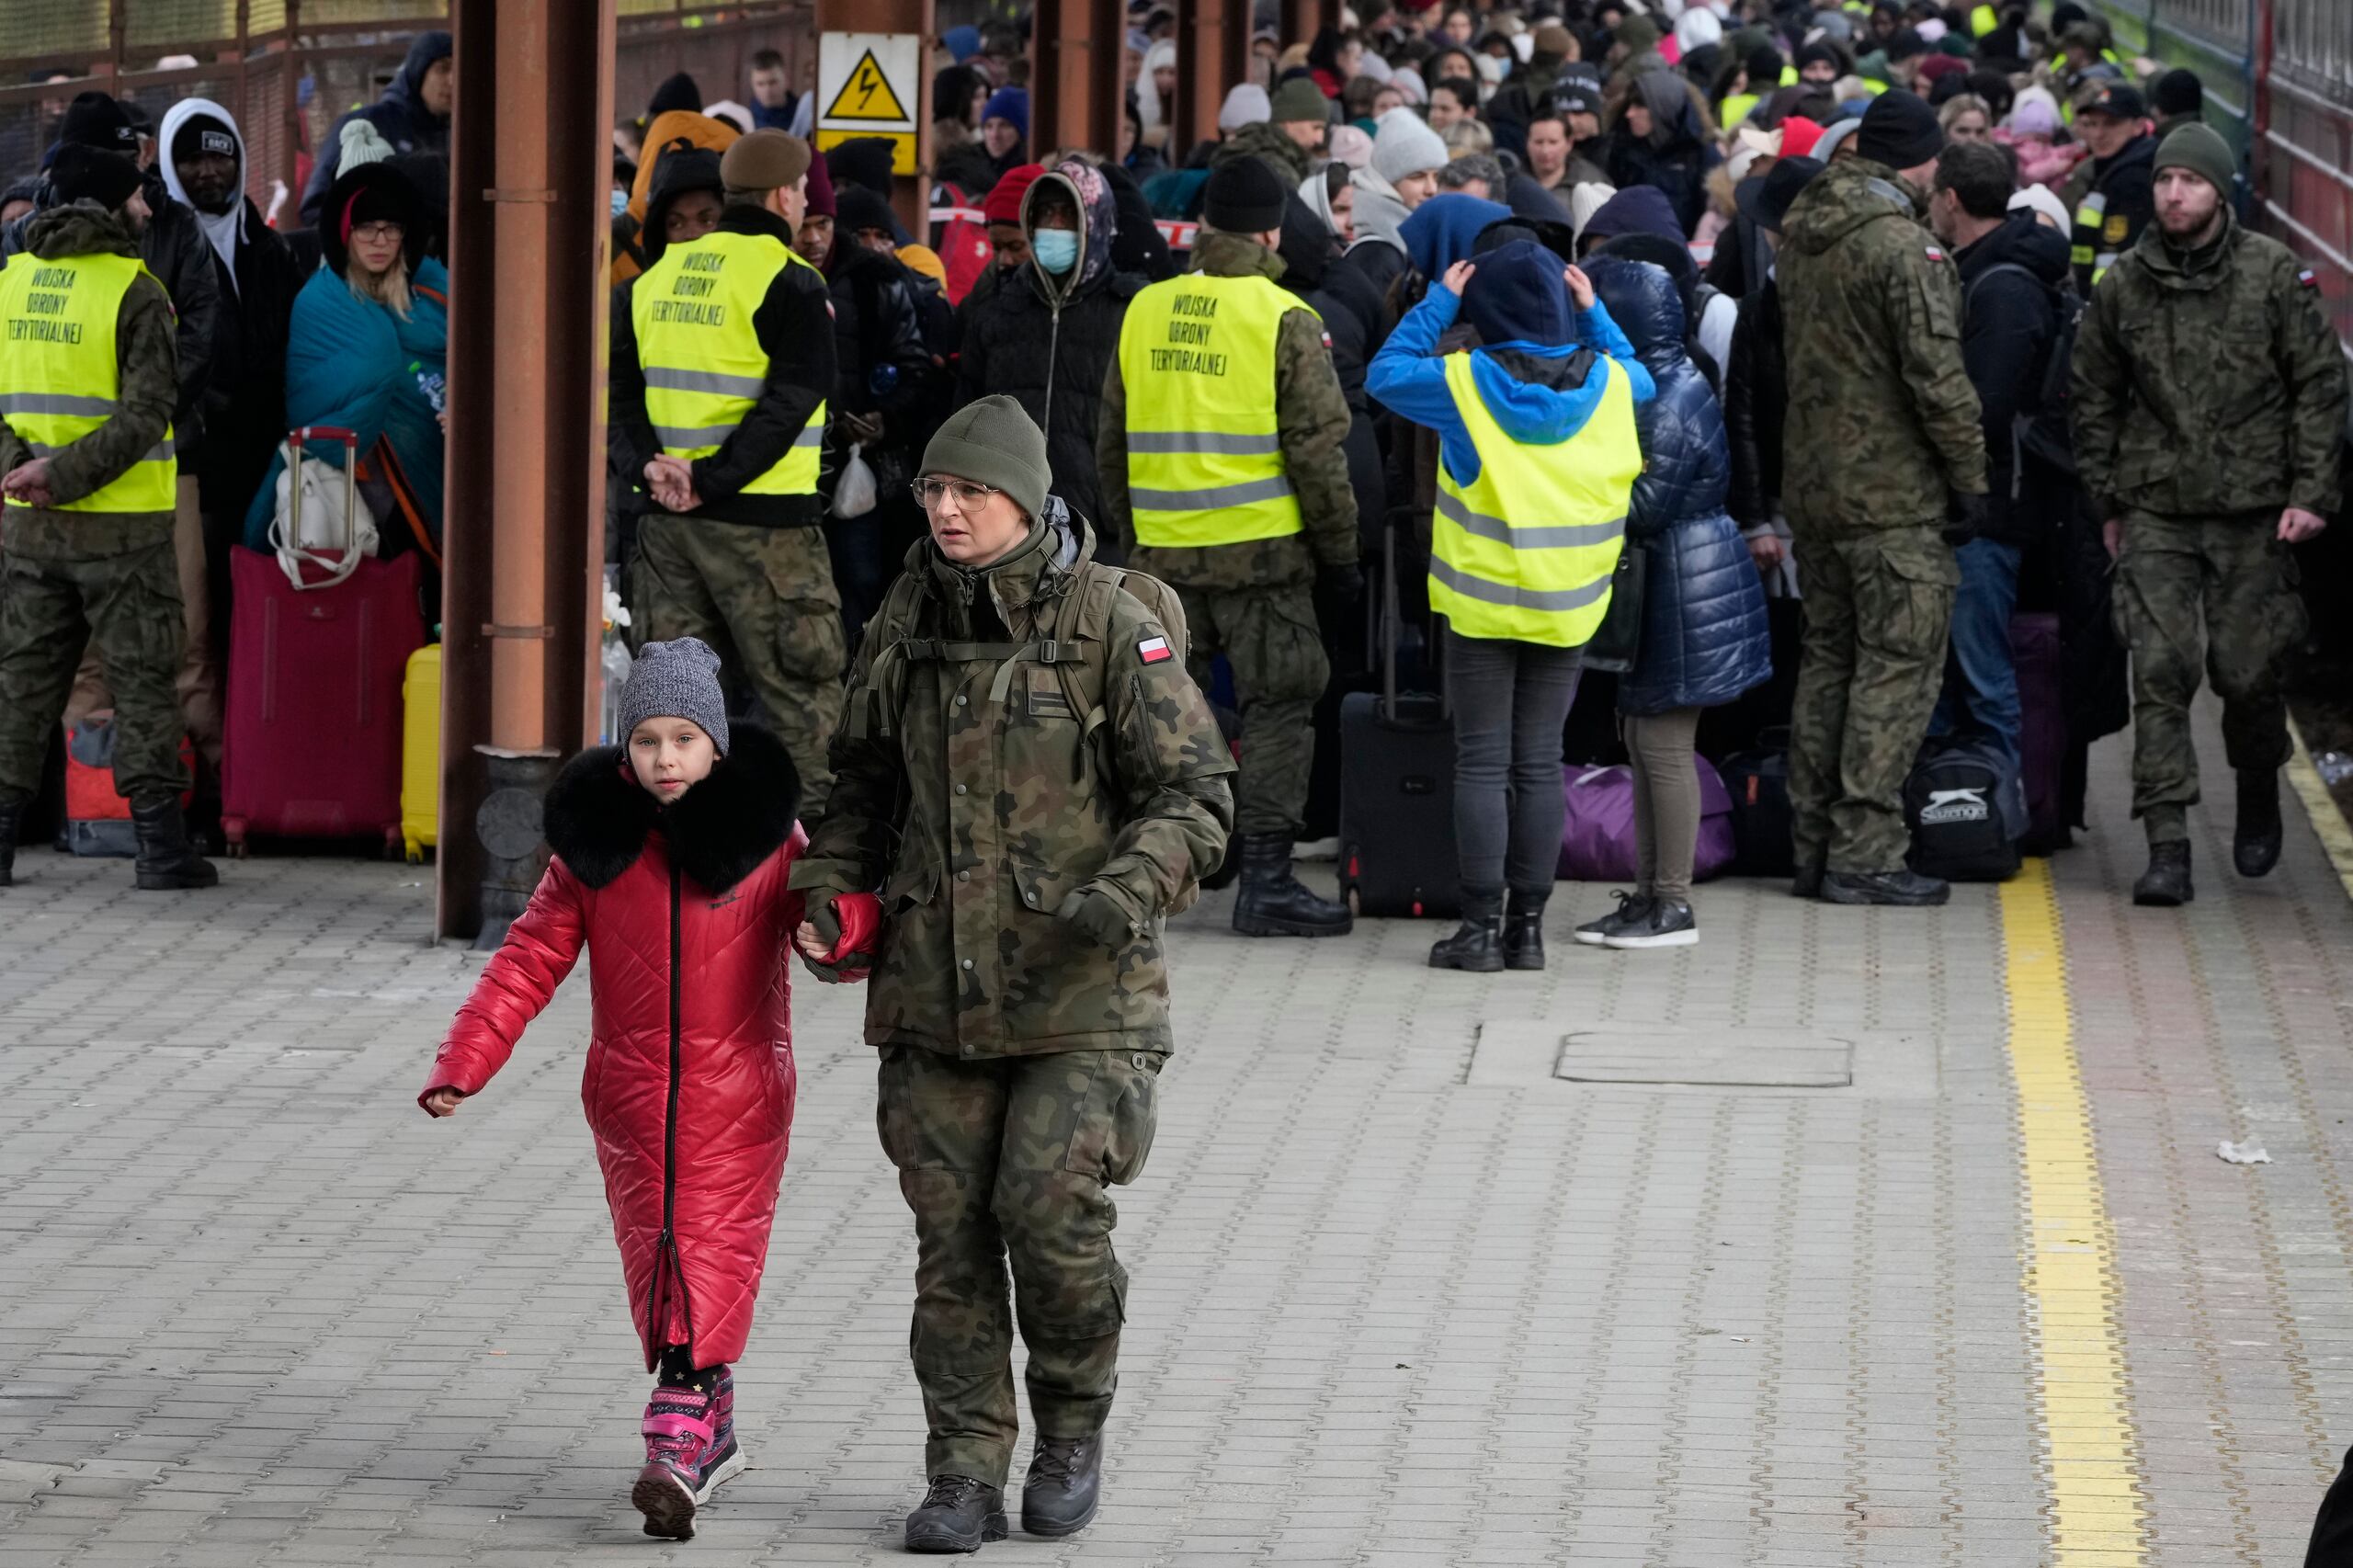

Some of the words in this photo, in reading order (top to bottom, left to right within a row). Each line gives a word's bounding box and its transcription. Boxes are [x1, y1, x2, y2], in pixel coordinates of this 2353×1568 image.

[682, 253, 726, 272] WOJSKA
[31, 267, 76, 289] WOJSKA
[673, 276, 718, 298] OBRONY
[27, 292, 70, 315] OBRONY
[652, 301, 726, 326] TERYTORIALNEJ
[1173, 294, 1218, 318] WOJSKA
[7, 319, 82, 345] TERYTORIALNEJ
[1168, 321, 1212, 346] OBRONY
[1920, 804, 1988, 824] Slazenger
